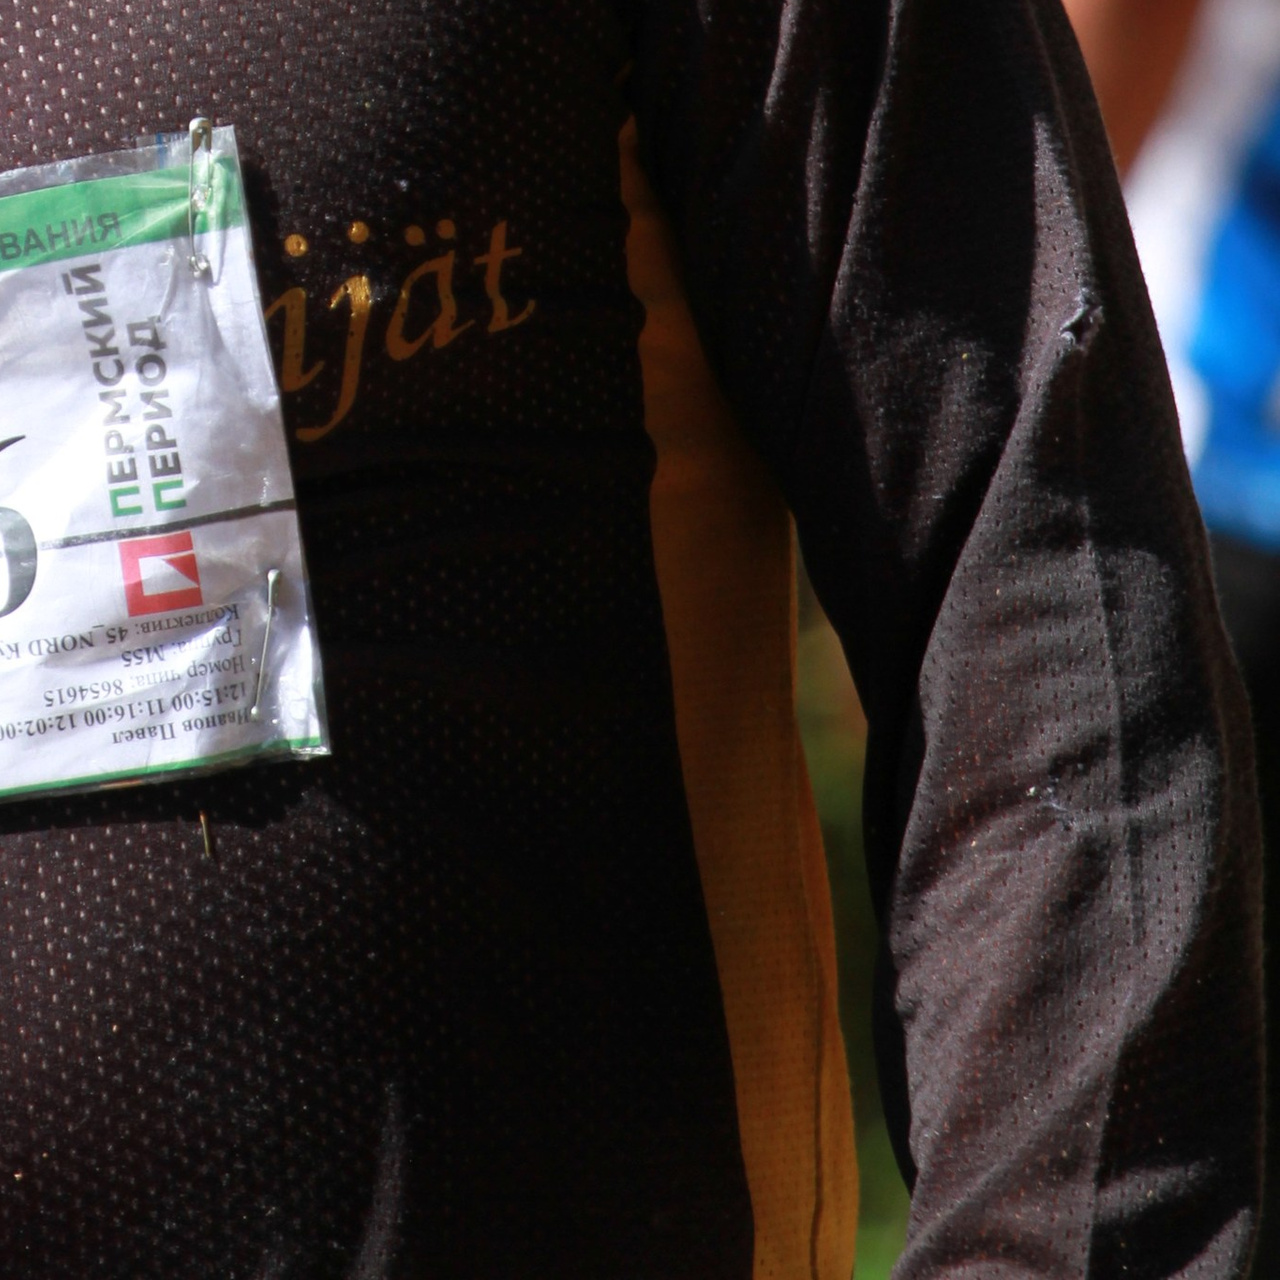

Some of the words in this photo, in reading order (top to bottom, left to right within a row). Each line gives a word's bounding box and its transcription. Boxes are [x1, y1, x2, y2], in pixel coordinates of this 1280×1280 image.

[62, 263, 143, 518] ПЕРМСКИЙ
[126, 314, 187, 512] ПЕРИОД
[28, 625, 128, 656] 45_NORD
[187, 655, 246, 679] Номер
[44, 678, 124, 708] 8654615
[171, 681, 247, 712] 12:15:00
[84, 697, 166, 727] 11:16:00
[112, 721, 176, 745] Павел
